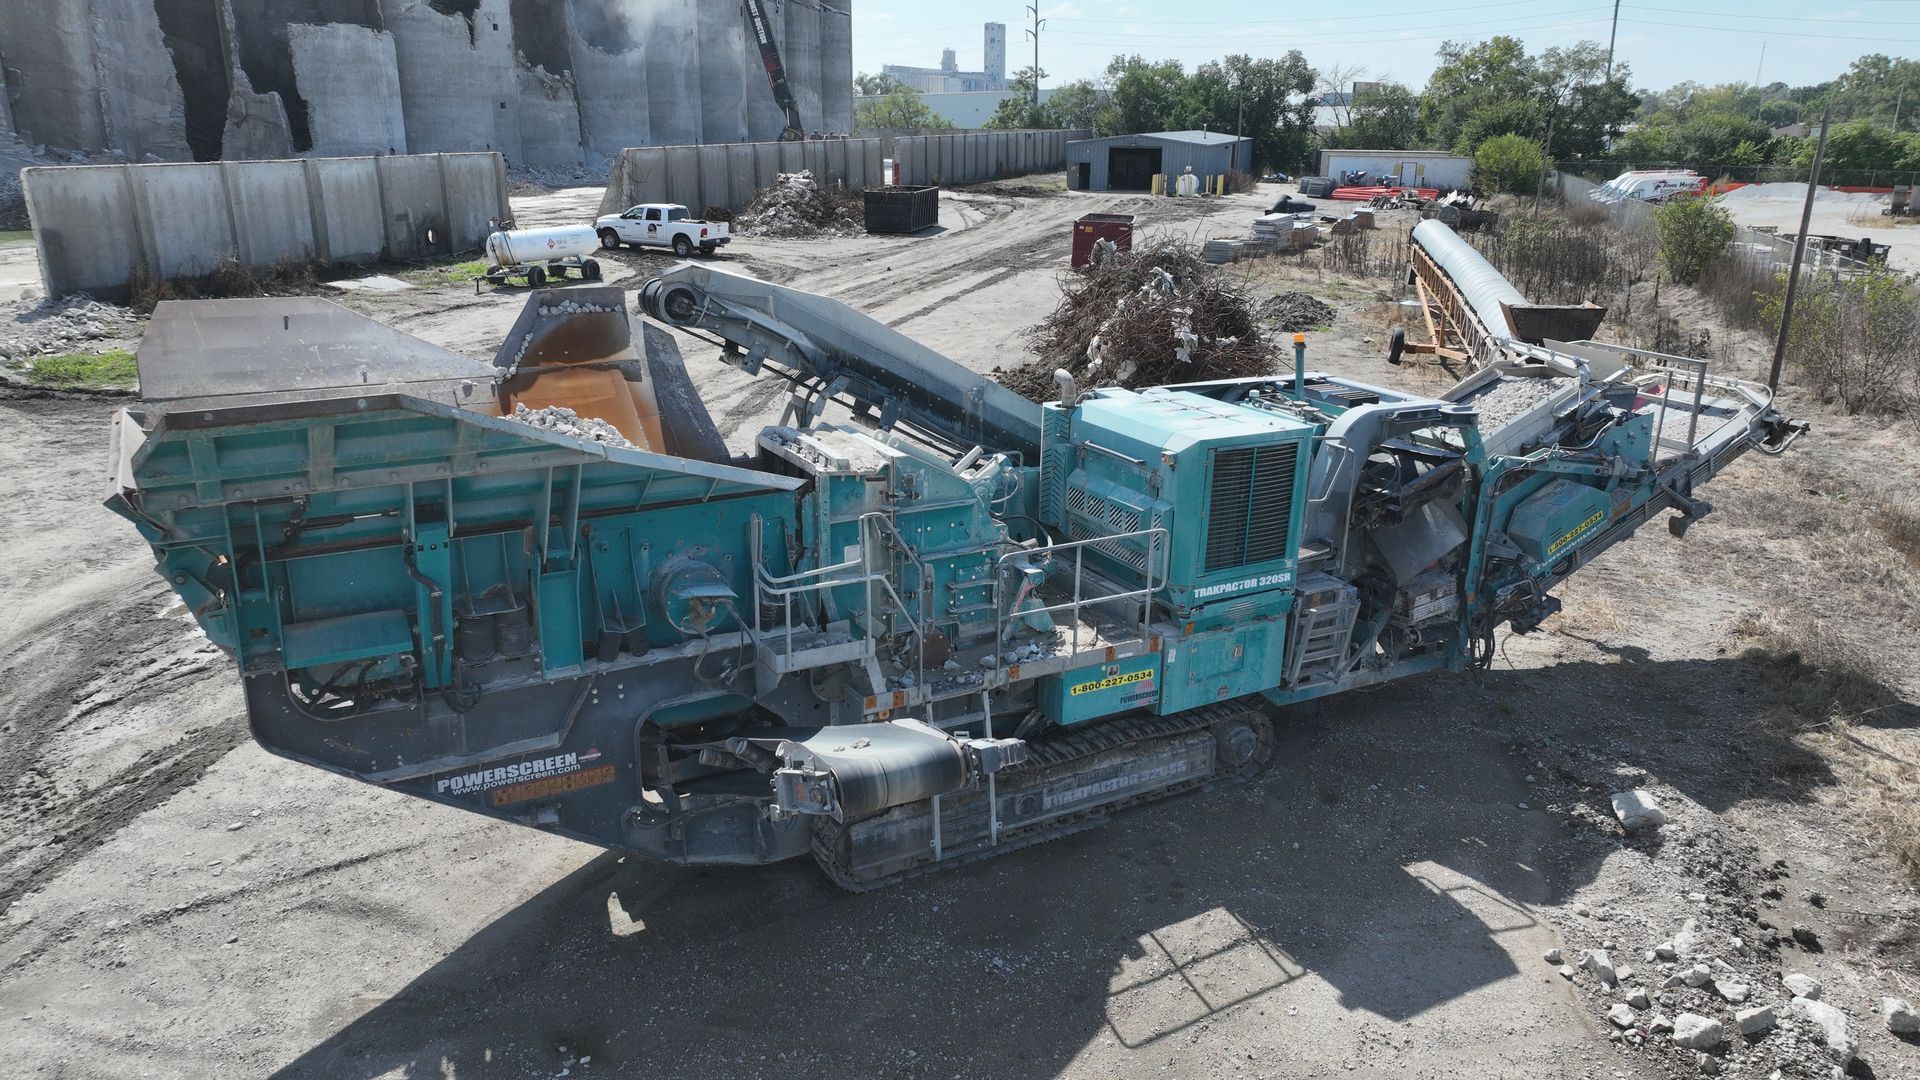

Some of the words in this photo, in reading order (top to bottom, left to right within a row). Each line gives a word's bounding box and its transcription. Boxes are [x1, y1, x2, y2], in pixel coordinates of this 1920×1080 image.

[1548, 512, 1603, 553] 1-800-227-0534
[1193, 578, 1258, 599] TRAKPACTOR
[1259, 572, 1292, 587] 320SR
[1071, 670, 1153, 695] 1-800-227-0534
[436, 752, 577, 794] POWERSCREEN
[452, 763, 581, 796] www.powerscreen.com
